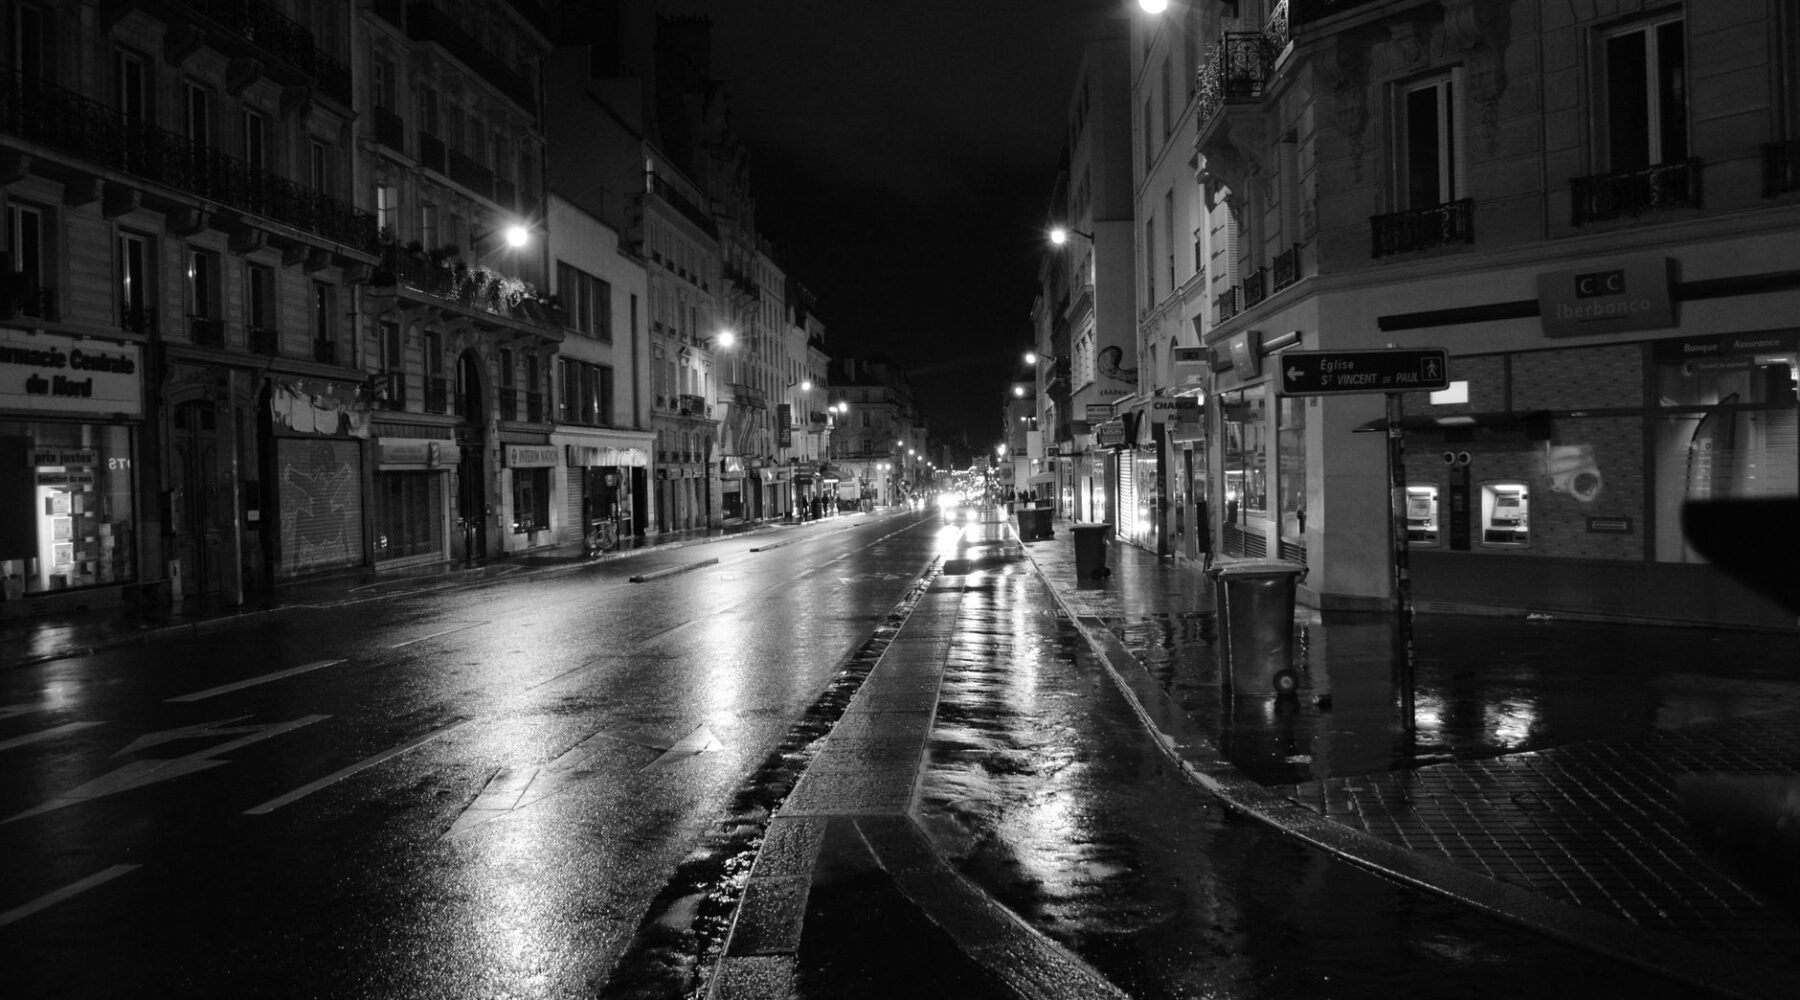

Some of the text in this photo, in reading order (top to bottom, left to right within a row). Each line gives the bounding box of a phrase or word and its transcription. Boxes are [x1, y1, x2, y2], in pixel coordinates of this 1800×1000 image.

[1556, 299, 1651, 320] Iberbanco
[1684, 340, 1780, 353] Banque Assurance
[71, 349, 134, 374] Centrale
[1320, 357, 1354, 373] Église
[26, 373, 92, 397] du Nord
[1337, 373, 1377, 384] VINCENT
[1396, 371, 1419, 383] PAUL
[1154, 402, 1197, 410] CHANGE
[34, 451, 56, 465] prix
